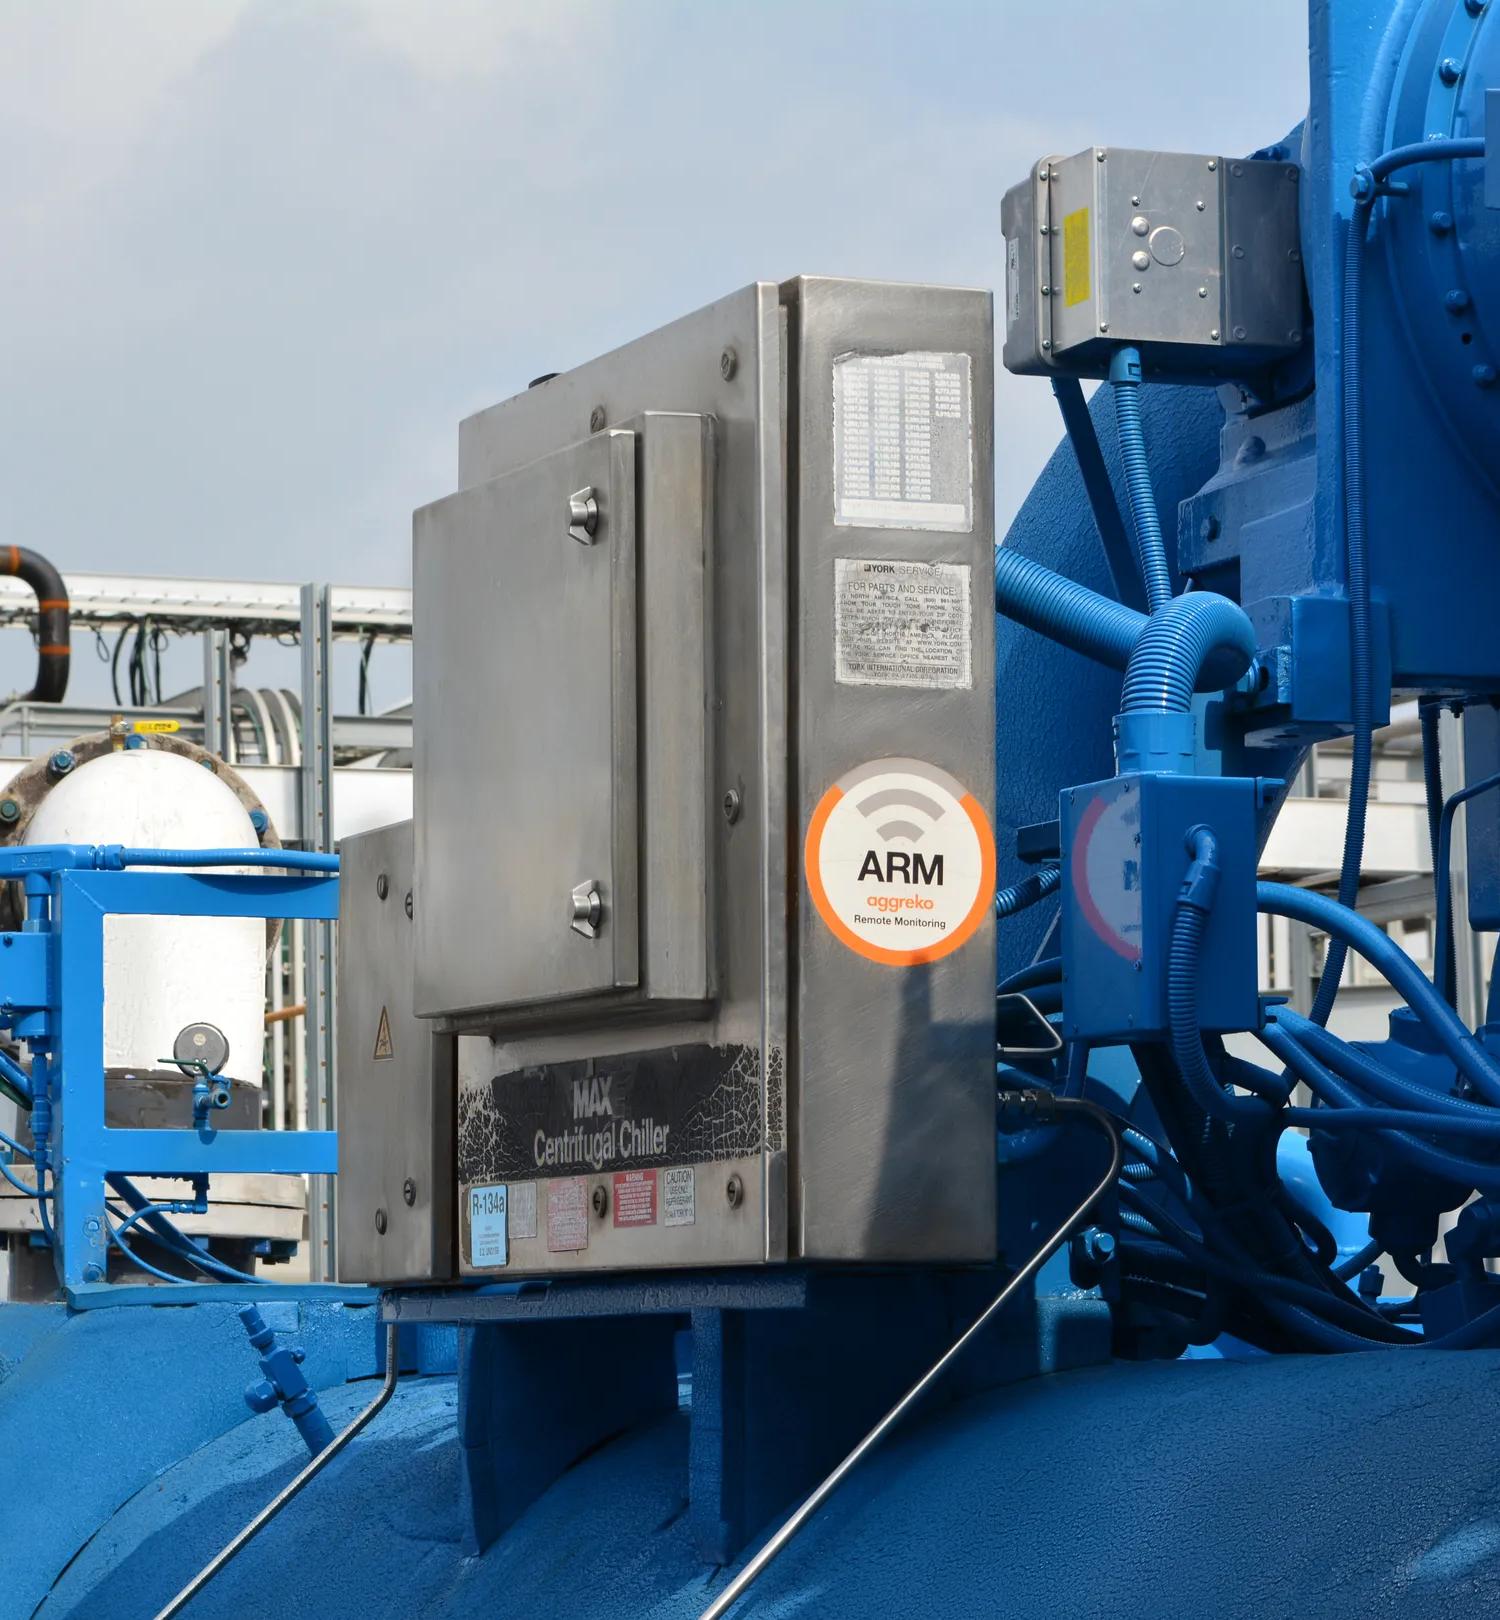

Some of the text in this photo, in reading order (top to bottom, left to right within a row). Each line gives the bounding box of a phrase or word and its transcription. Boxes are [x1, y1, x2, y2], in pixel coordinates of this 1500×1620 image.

[871, 564, 941, 577] YORK SERVICE
[848, 582, 866, 592] FOR
[868, 583, 896, 593] PARTS
[898, 584, 916, 594] AND
[866, 664, 914, 672] INTERNATIONAL
[857, 850, 944, 886] ARM
[867, 894, 934, 912] aggreko
[854, 914, 946, 930] Remote Monitoring
[573, 1077, 614, 1119] MAX
[534, 1117, 670, 1170] Centrifugal Chiller
[473, 1192, 504, 1216] R-134a
